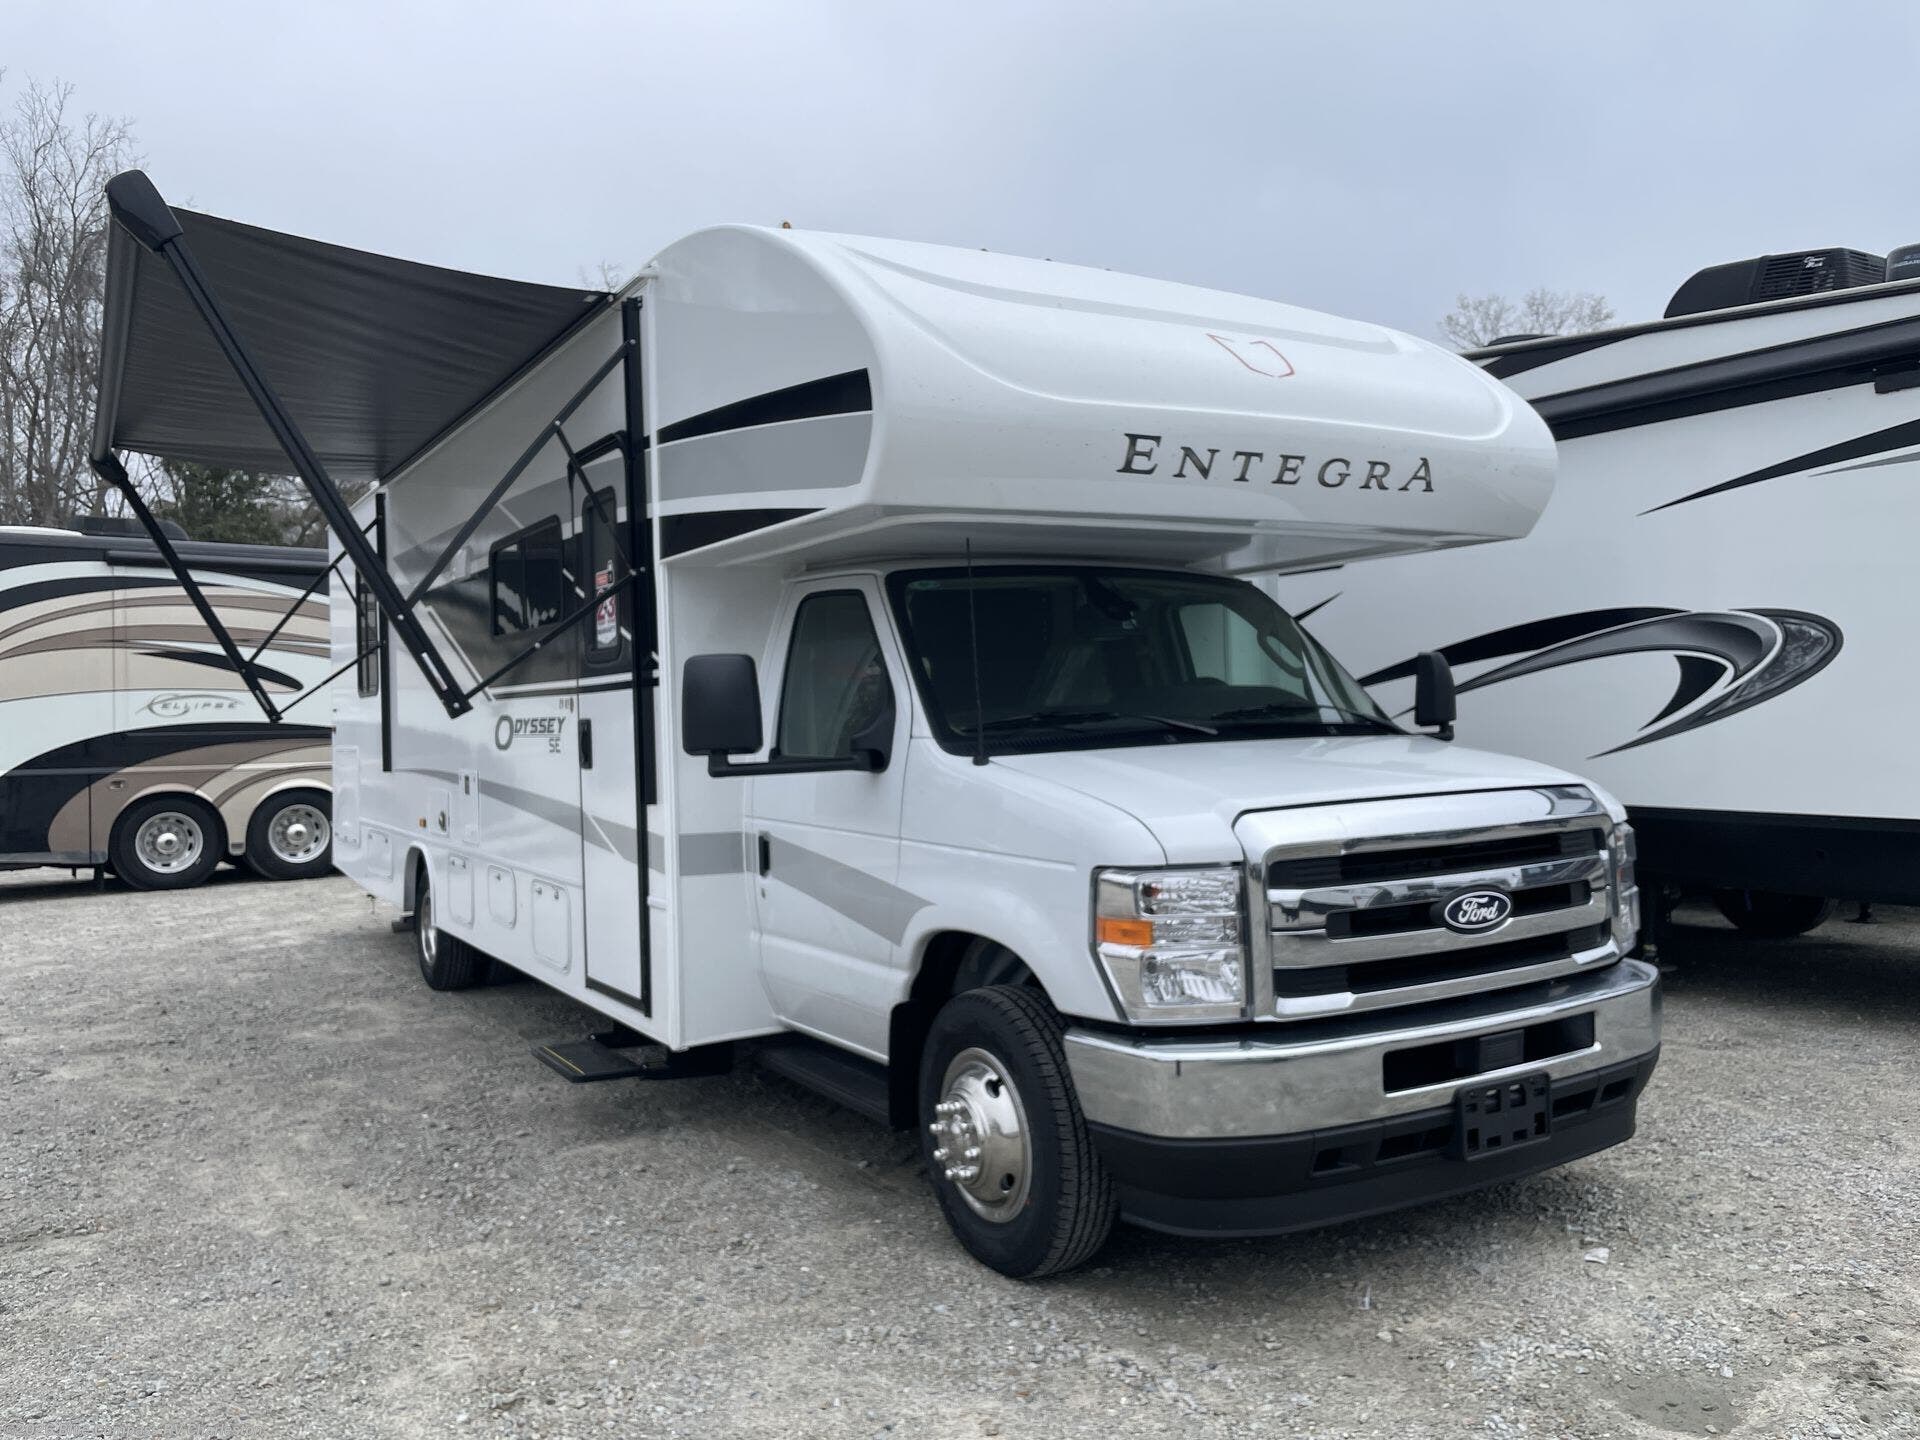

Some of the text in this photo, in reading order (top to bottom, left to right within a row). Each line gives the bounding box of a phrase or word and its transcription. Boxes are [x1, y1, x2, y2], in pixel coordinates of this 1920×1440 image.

[1116, 432, 1435, 493] ENTEGRA
[494, 714, 567, 751] ODYSSEY
[549, 737, 562, 753] SE
[1458, 896, 1499, 924] Ford
